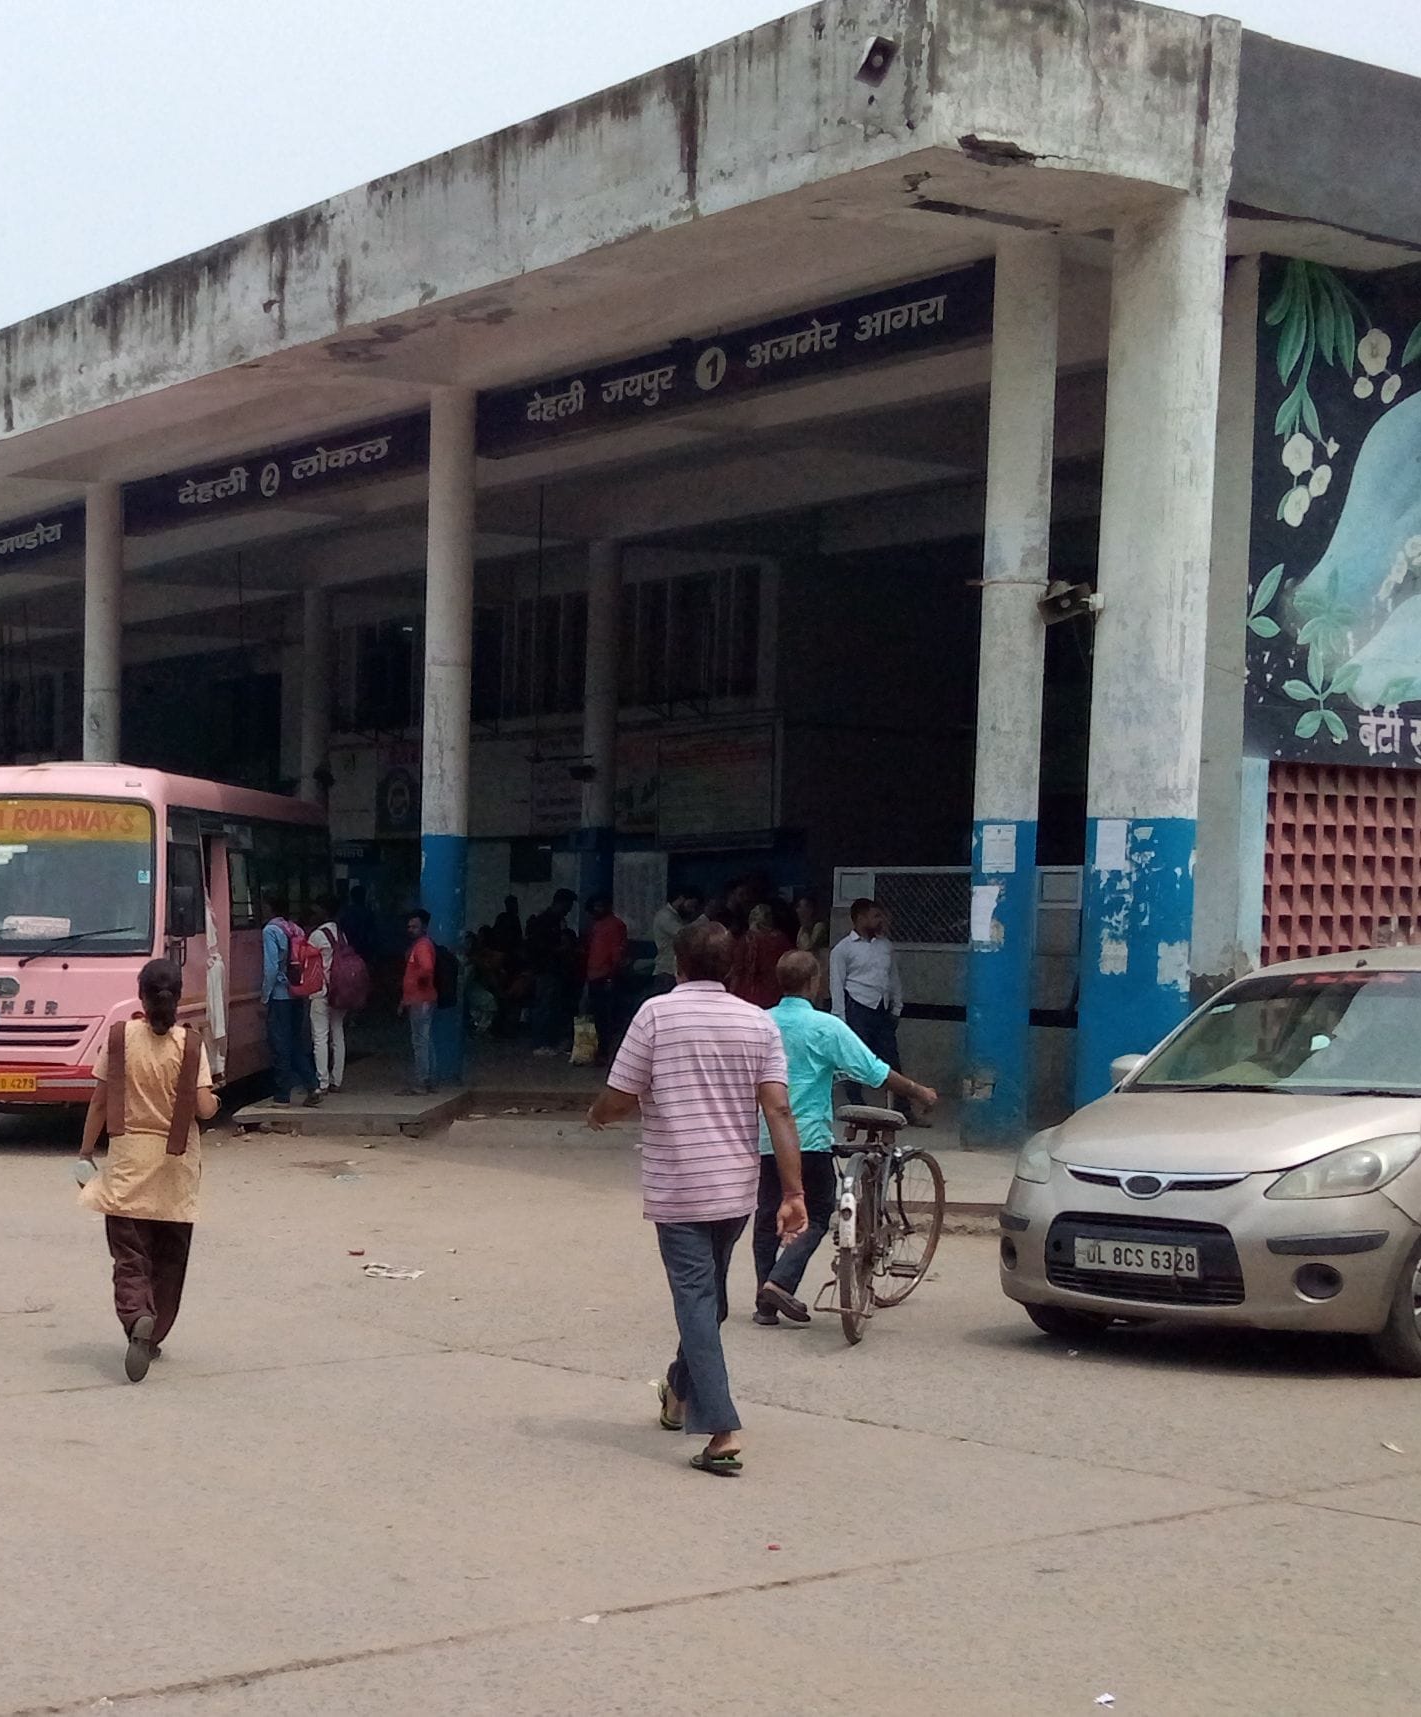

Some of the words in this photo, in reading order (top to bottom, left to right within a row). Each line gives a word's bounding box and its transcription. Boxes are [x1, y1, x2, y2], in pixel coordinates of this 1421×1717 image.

[526, 379, 586, 421] देहली
[600, 365, 677, 407] जयपुर
[745, 318, 842, 369] अजमेर
[853, 294, 948, 342] आगरा
[177, 466, 250, 505] देहली
[291, 435, 392, 480] लोकल
[1357, 703, 1405, 757] बेटी
[12, 807, 136, 832] ROADWAYS
[10, 1077, 35, 1089] 4279
[1113, 1246, 1145, 1269] 8CS
[1150, 1250, 1196, 1273] 6328
